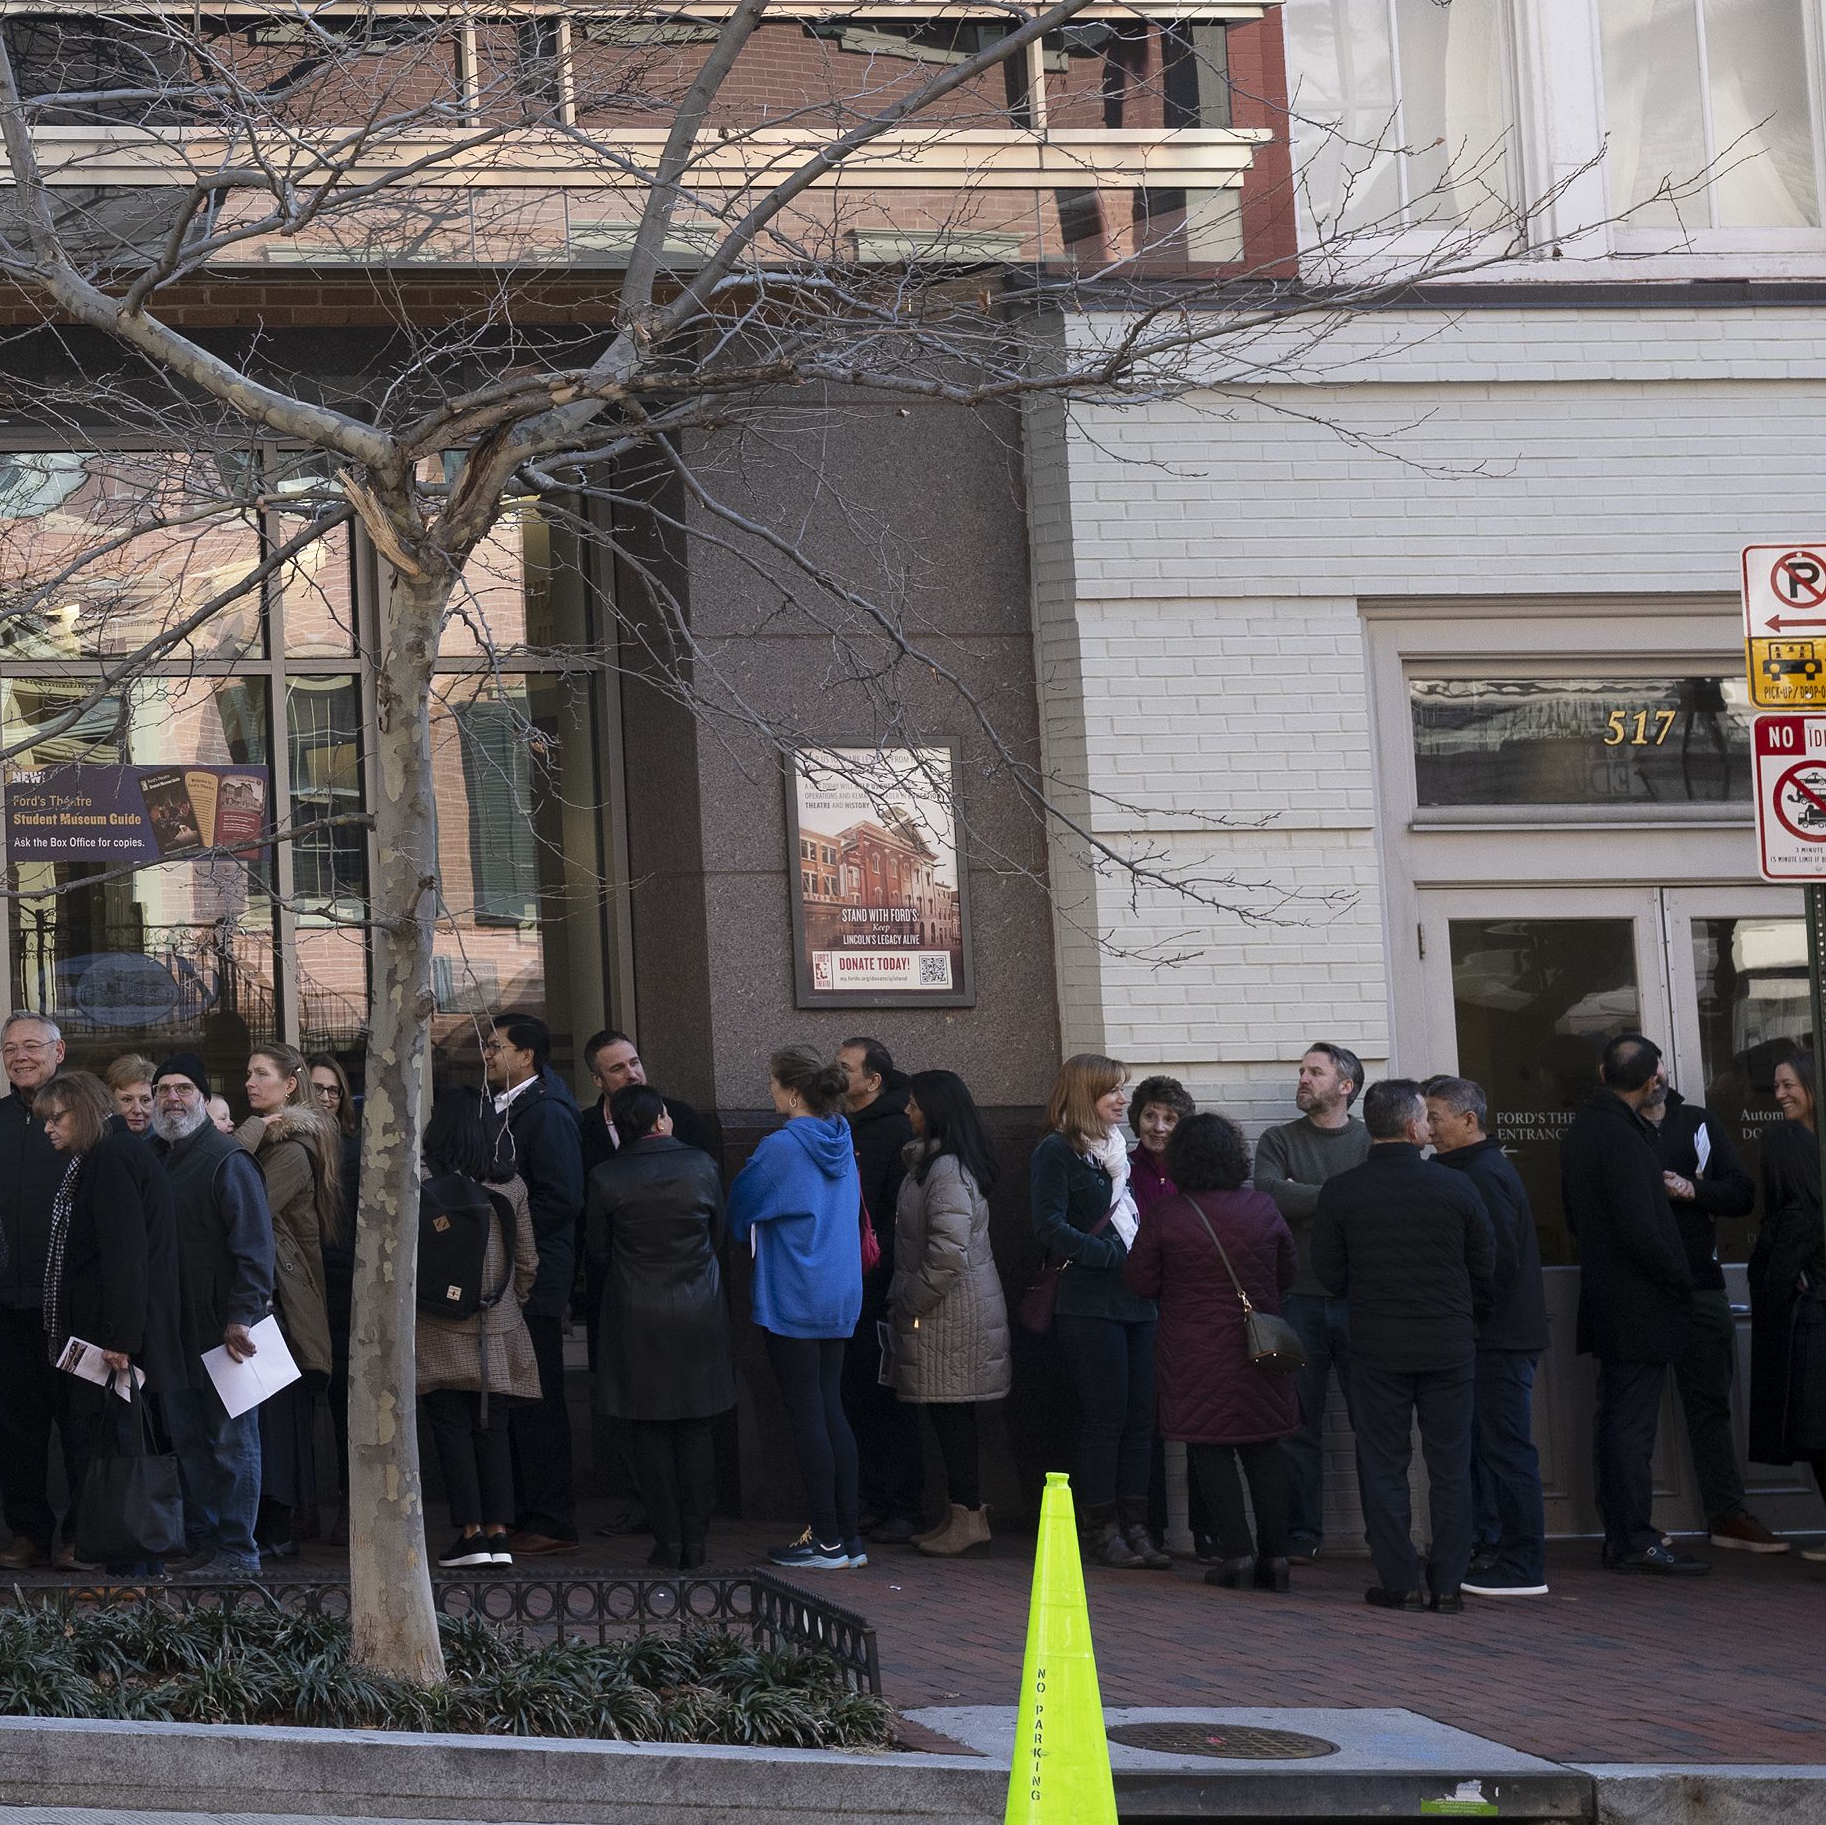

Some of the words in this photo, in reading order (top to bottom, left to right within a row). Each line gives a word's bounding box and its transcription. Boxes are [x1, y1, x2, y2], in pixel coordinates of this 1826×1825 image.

[1604, 709, 1677, 746] 517
[1768, 726, 1794, 748] NO
[12, 772, 46, 784] NEW!
[13, 796, 46, 806] Ford's
[49, 796, 92, 806] Thetre
[13, 814, 57, 825] Student
[60, 814, 106, 825] Museum
[109, 813, 142, 825] Guide
[14, 838, 30, 847] Ask
[33, 838, 48, 847] the
[50, 838, 67, 847] Box
[70, 837, 96, 847] Office
[98, 837, 111, 847] for
[113, 837, 145, 849] copies.
[842, 908, 867, 922] STAND
[868, 908, 889, 922] WITH
[890, 908, 920, 922] FORD'S:
[872, 924, 891, 933] Keep
[843, 934, 876, 945] LINCOLN'S
[877, 934, 901, 945] LEGACY
[902, 934, 920, 945] ALIVE
[839, 958, 874, 970] DONATE
[877, 957, 910, 970] TODAY!
[1496, 1112, 1546, 1124] FORD'S
[1036, 1668, 1046, 1693] NO
[1031, 1705, 1044, 1801] PARKING
